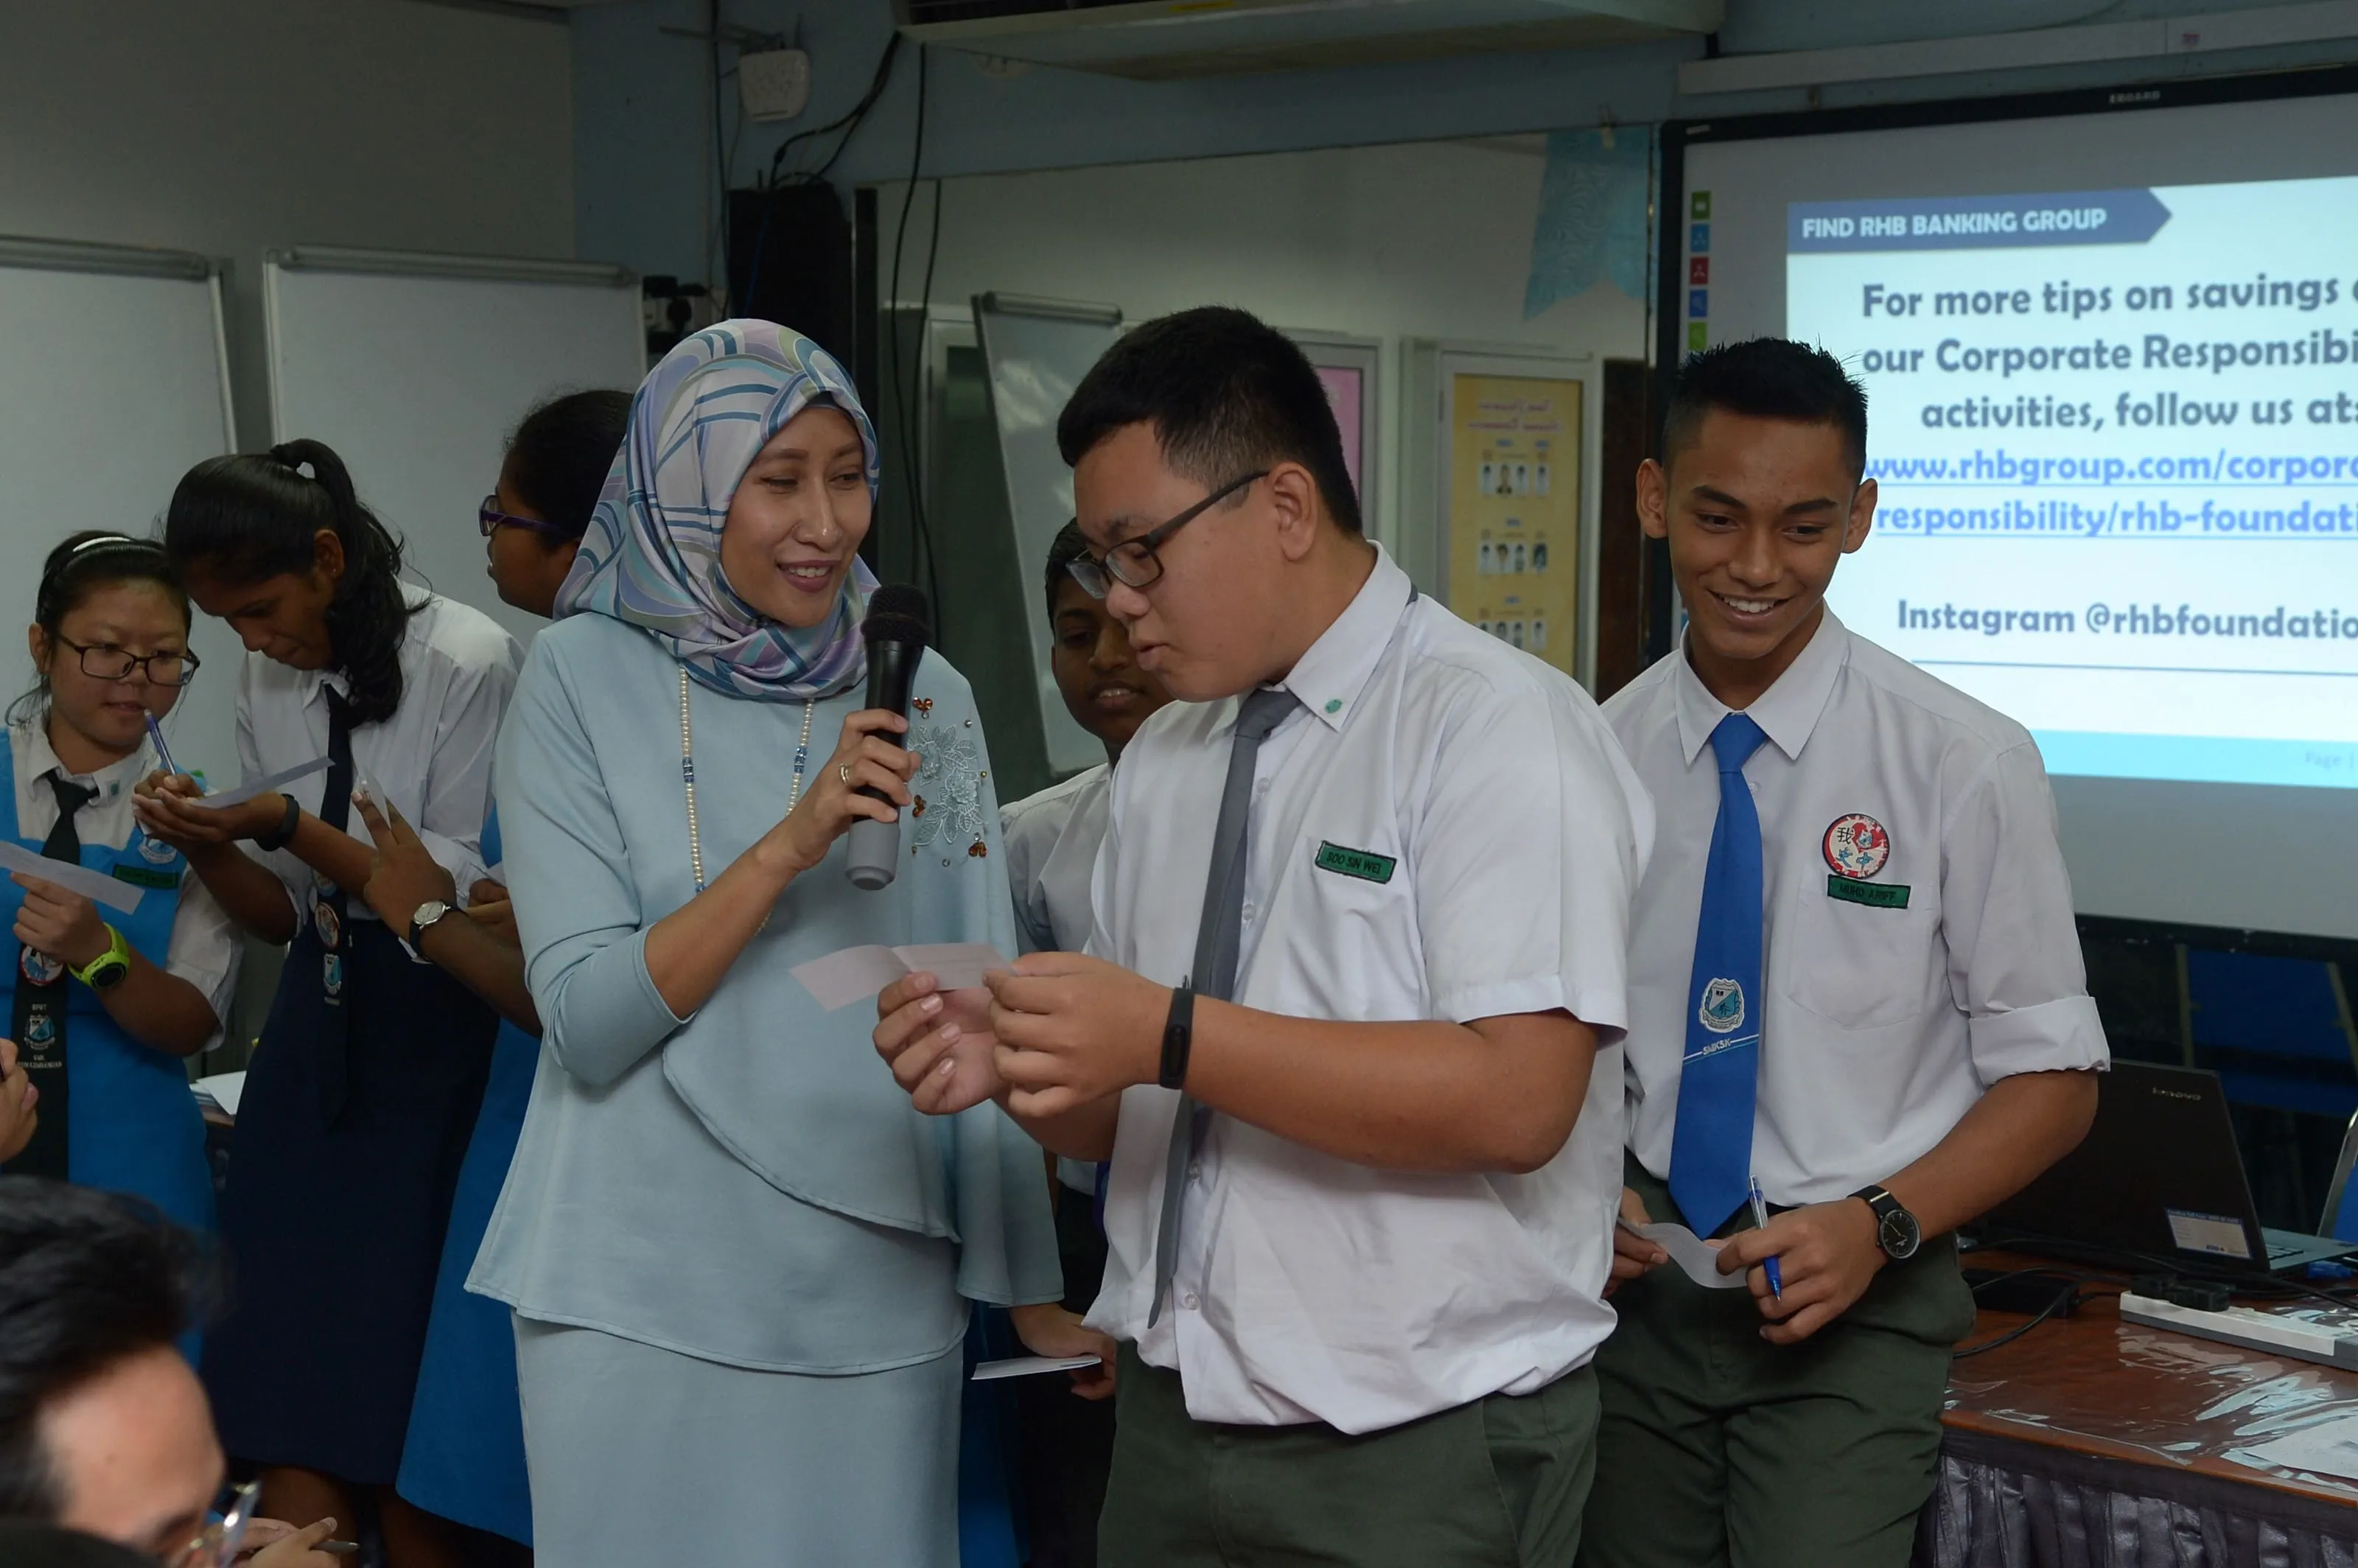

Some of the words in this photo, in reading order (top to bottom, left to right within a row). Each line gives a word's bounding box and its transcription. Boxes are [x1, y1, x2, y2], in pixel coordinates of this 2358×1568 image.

[1802, 218, 1854, 238] FIND
[1859, 216, 1907, 237] RHB
[1912, 212, 2018, 235] BANKING
[2022, 208, 2107, 231] GROUP
[1863, 283, 1923, 317] For
[1934, 288, 2032, 316] more
[2043, 281, 2112, 320] tips
[2124, 284, 2173, 310] on
[2187, 273, 2339, 311] savings
[1863, 349, 1924, 372] our
[1936, 337, 2132, 378] Corporate
[1921, 395, 2105, 433] activities,
[2116, 391, 2239, 427] follow
[2251, 399, 2293, 424] us
[1898, 599, 2075, 636] Instagram
[2086, 602, 2358, 640] @rhbfoundatio
[1837, 827, 1854, 844] 我
